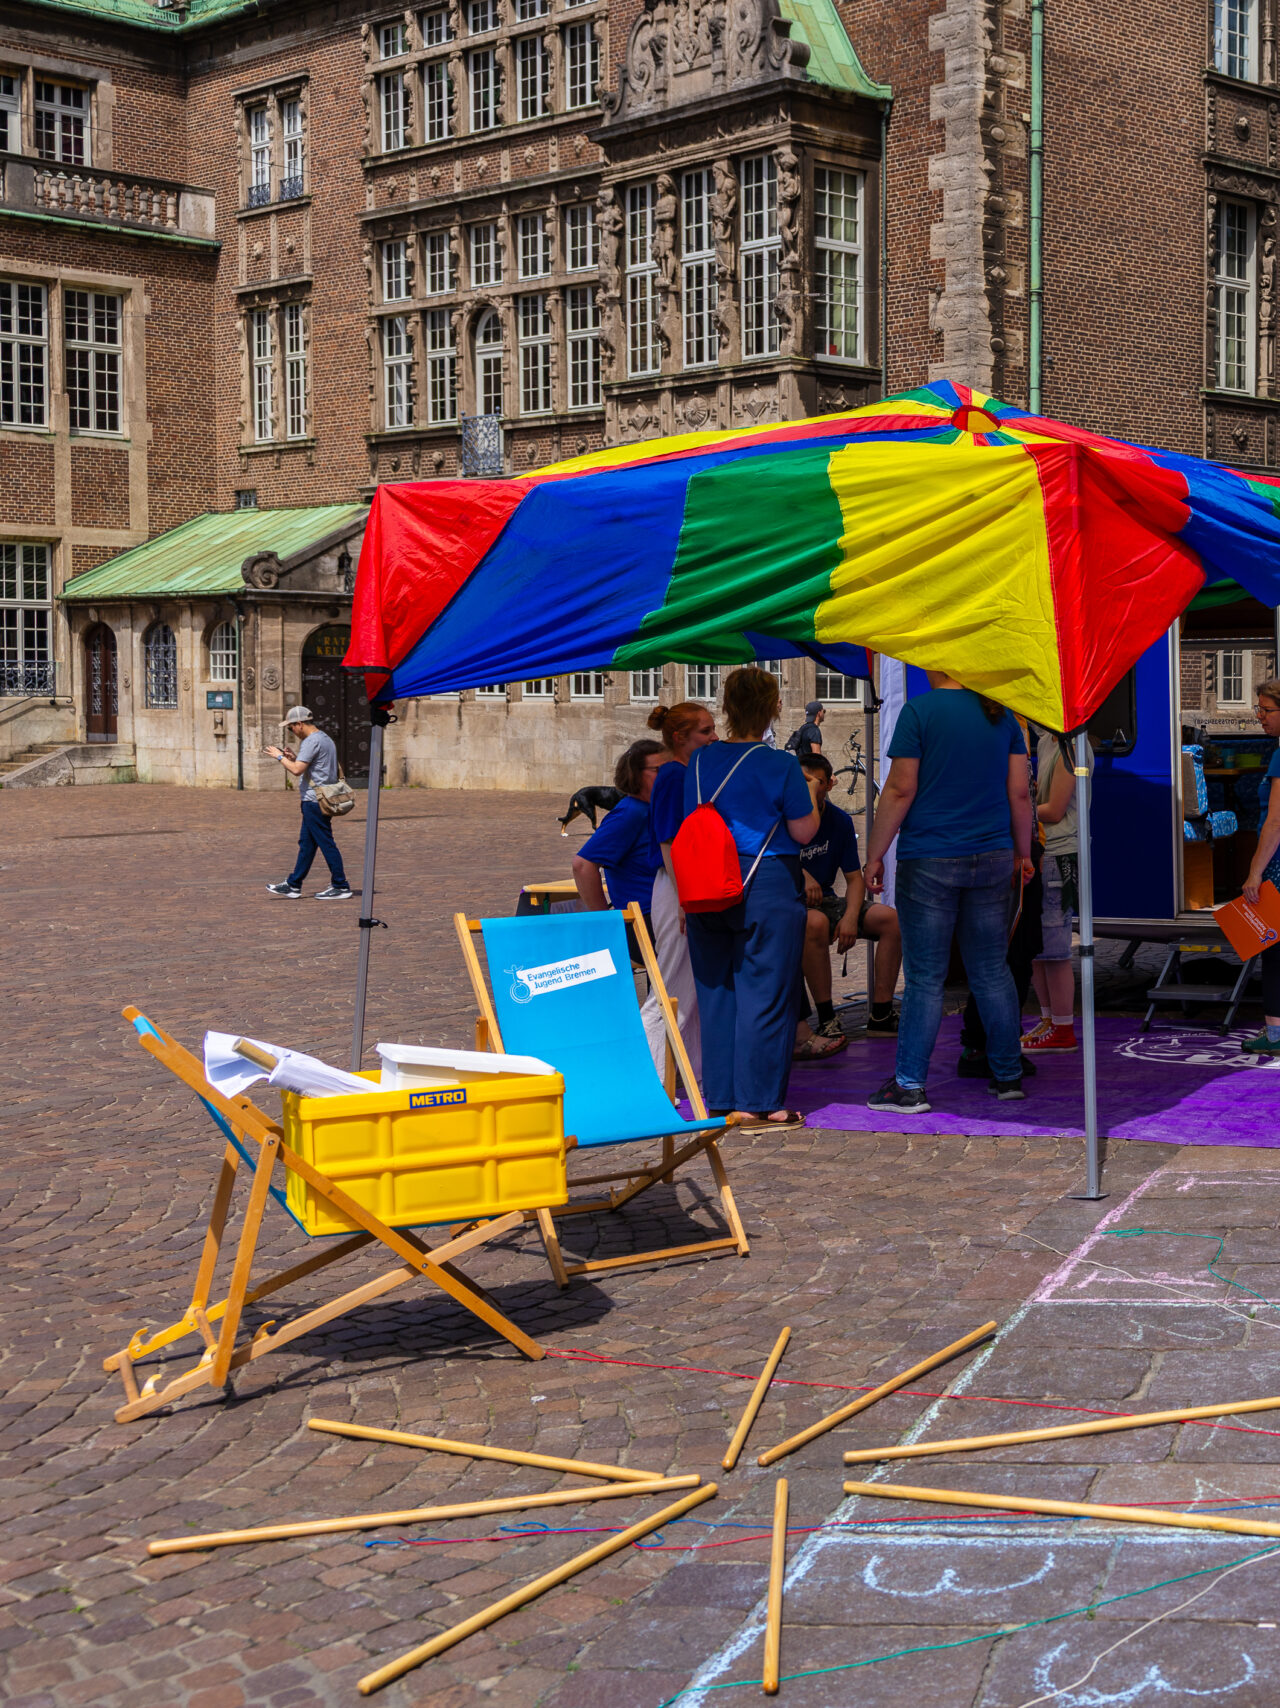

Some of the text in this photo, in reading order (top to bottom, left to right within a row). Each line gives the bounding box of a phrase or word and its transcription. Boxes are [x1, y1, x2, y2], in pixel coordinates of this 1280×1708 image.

[324, 636, 351, 646] RAT
[527, 963, 580, 981] Evangelische
[534, 967, 597, 988] Jugend Bremen
[411, 1091, 465, 1107] METRO
